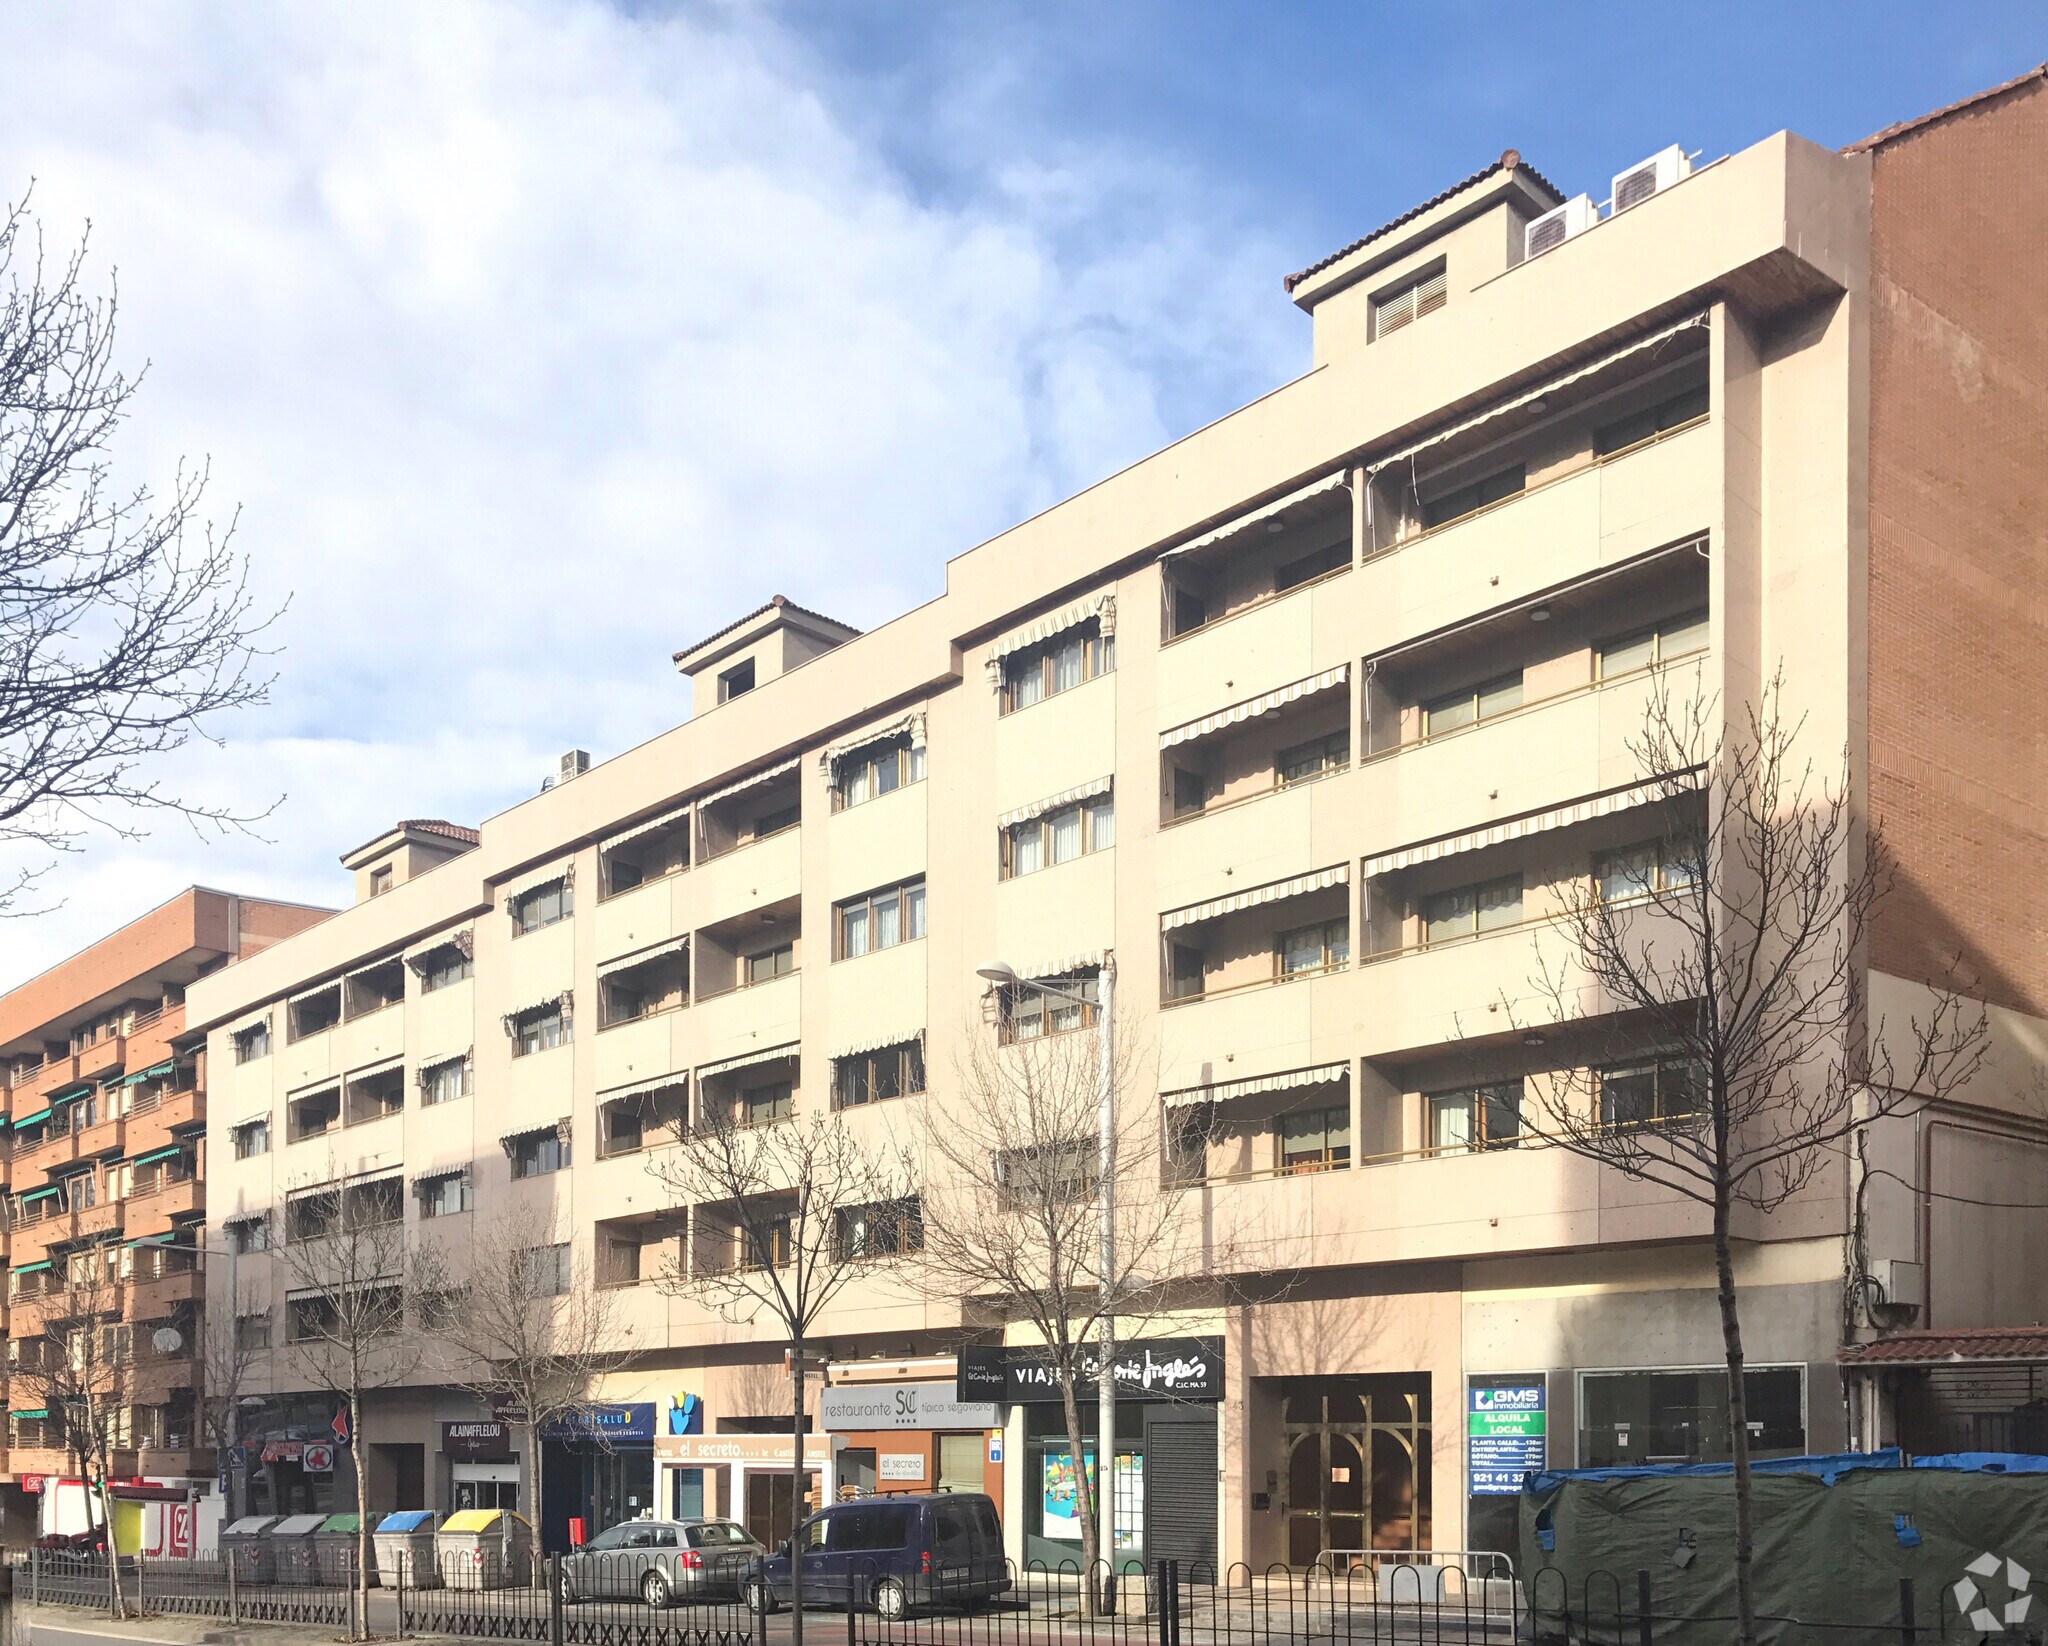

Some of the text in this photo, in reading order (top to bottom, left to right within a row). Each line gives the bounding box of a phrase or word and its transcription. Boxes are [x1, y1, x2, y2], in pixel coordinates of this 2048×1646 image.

[1142, 1349, 1207, 1389] Inglés
[1493, 1390, 1539, 1402] GMS
[825, 1402, 891, 1417] restaurante
[921, 1402, 944, 1413] típico
[947, 1402, 992, 1414] segoviano
[1494, 1401, 1539, 1409] inmobiliaria
[1484, 1413, 1531, 1422] ALQUILA
[1490, 1425, 1526, 1434] LOCAL
[680, 1440, 690, 1456] el
[882, 1459, 922, 1469] el secreto
[1473, 1473, 1493, 1483] 921
[1495, 1473, 1509, 1483] 41
